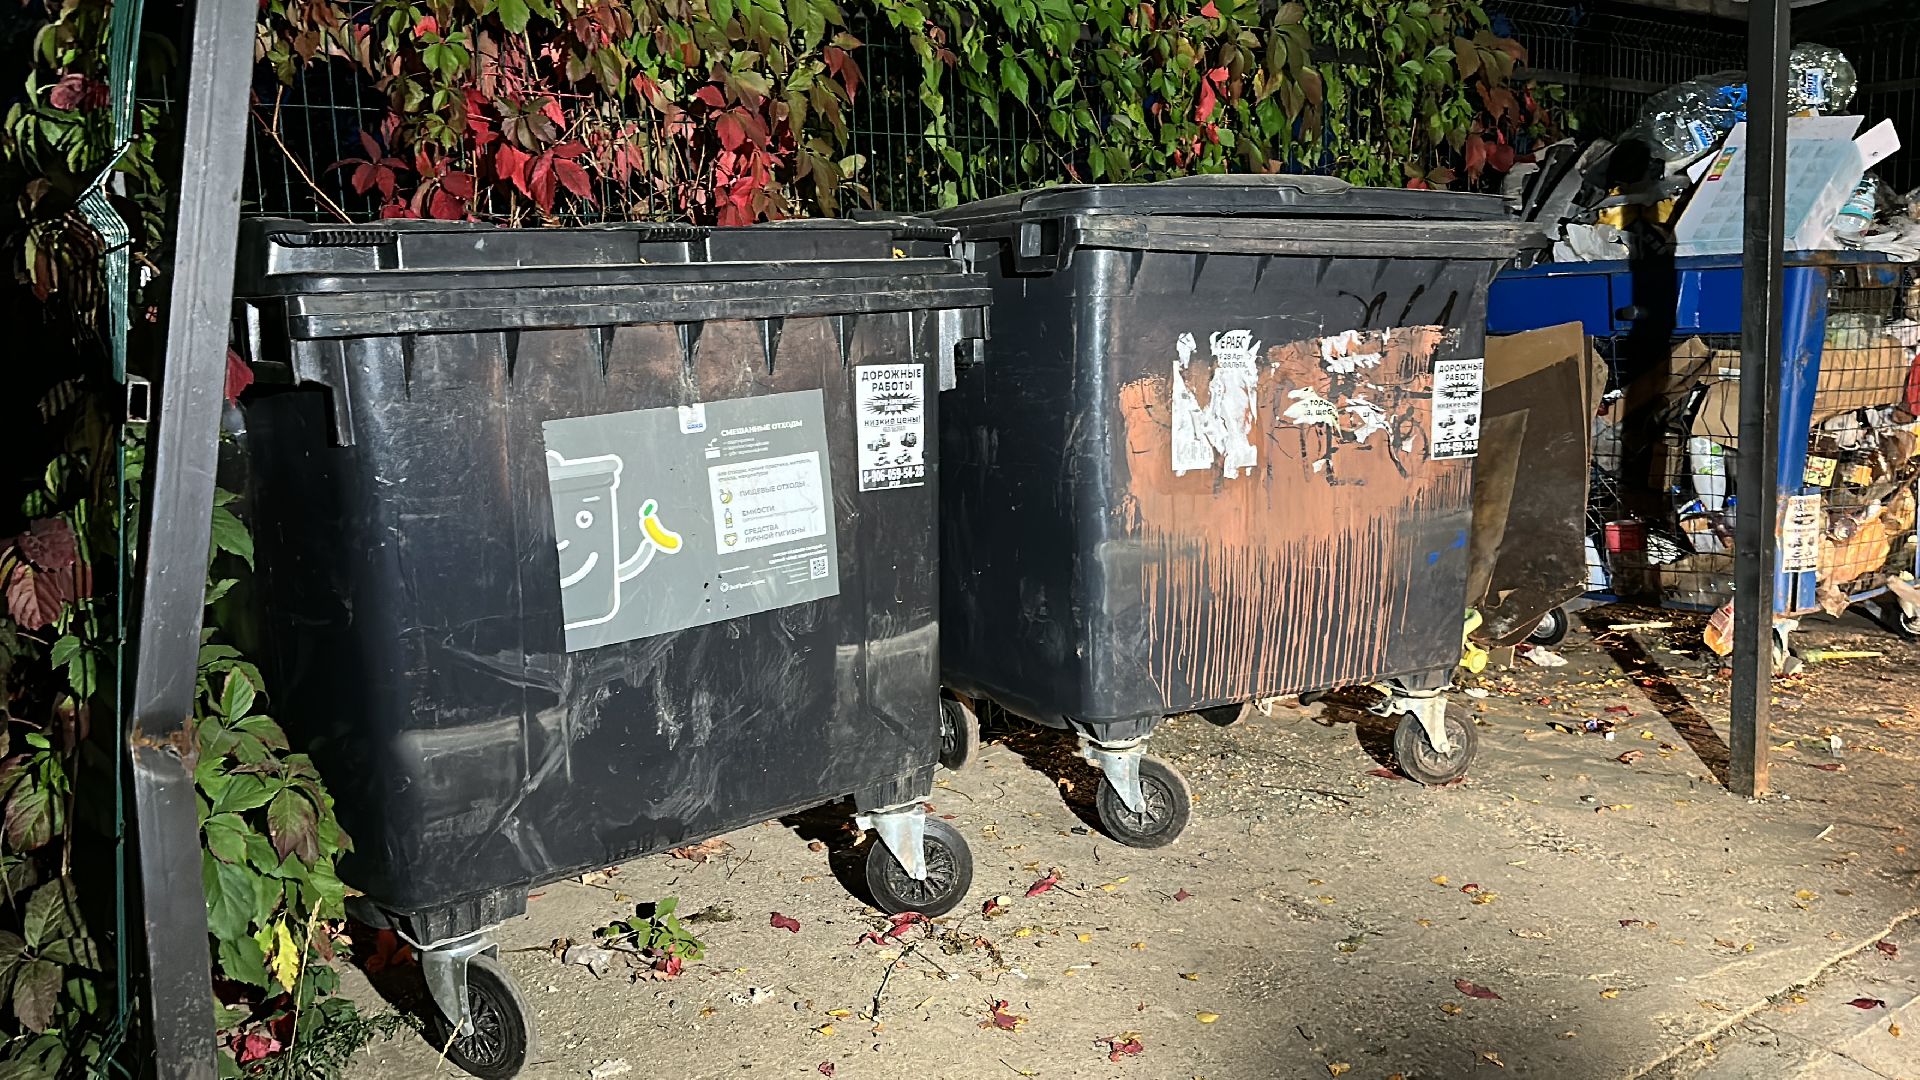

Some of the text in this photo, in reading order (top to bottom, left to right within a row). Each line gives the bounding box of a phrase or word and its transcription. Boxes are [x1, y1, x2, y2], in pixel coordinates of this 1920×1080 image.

[1438, 362, 1483, 373] ДОРОЖНЫЕ
[861, 368, 922, 382] ДОРОЖНЫЕ
[1445, 372, 1477, 381] РАБОТЫ
[872, 380, 913, 392] РАБОТЫ
[720, 420, 803, 437] СМЕШАННЫЕ ОТХОДЫ
[739, 481, 806, 497] ПИЩЕВЫЕ ОТХОДЫ
[743, 523, 779, 535] СРЕДСТВА
[744, 527, 806, 544] ЛИЧНОЙ ГИГИЕНЫ
